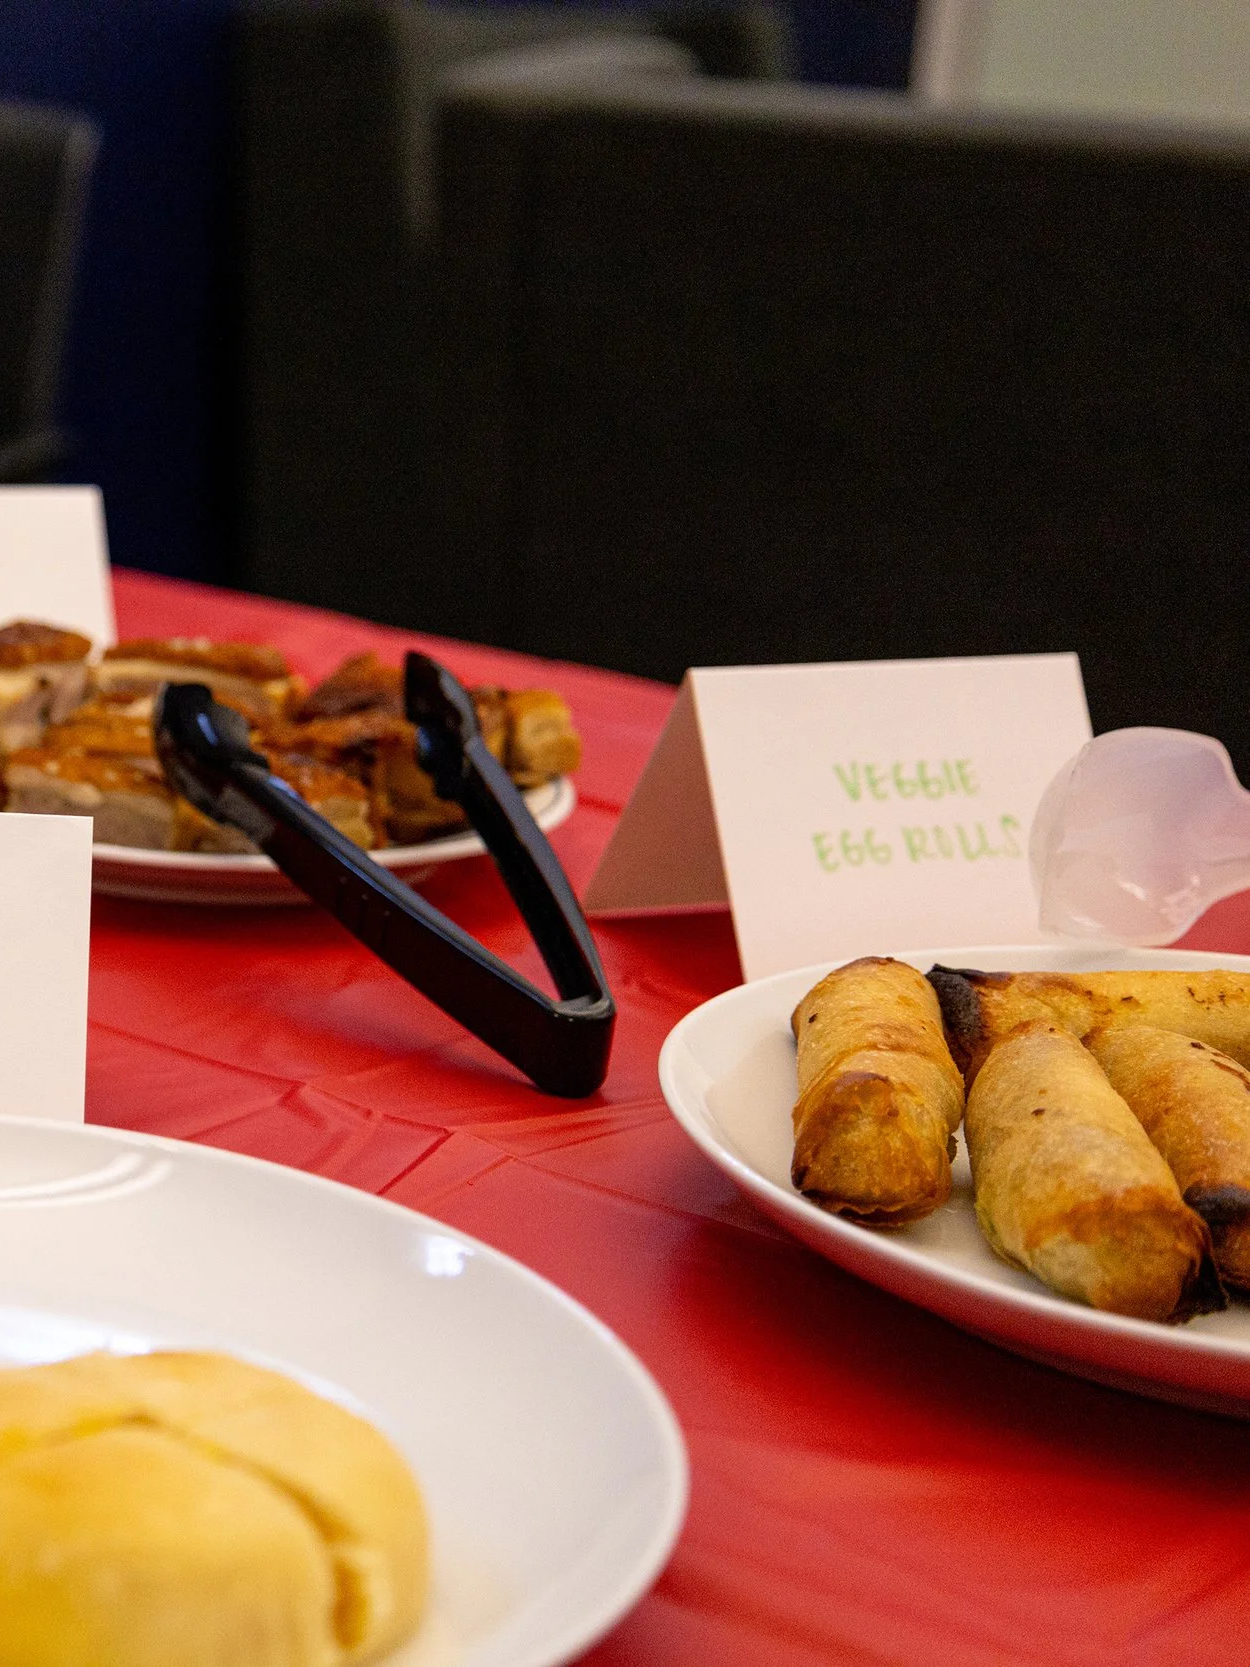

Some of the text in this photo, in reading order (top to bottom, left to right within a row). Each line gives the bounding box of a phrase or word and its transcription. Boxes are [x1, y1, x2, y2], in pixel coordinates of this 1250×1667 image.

[833, 759, 980, 802] VEGGIE
[812, 814, 1022, 873] EGG ROLLS
